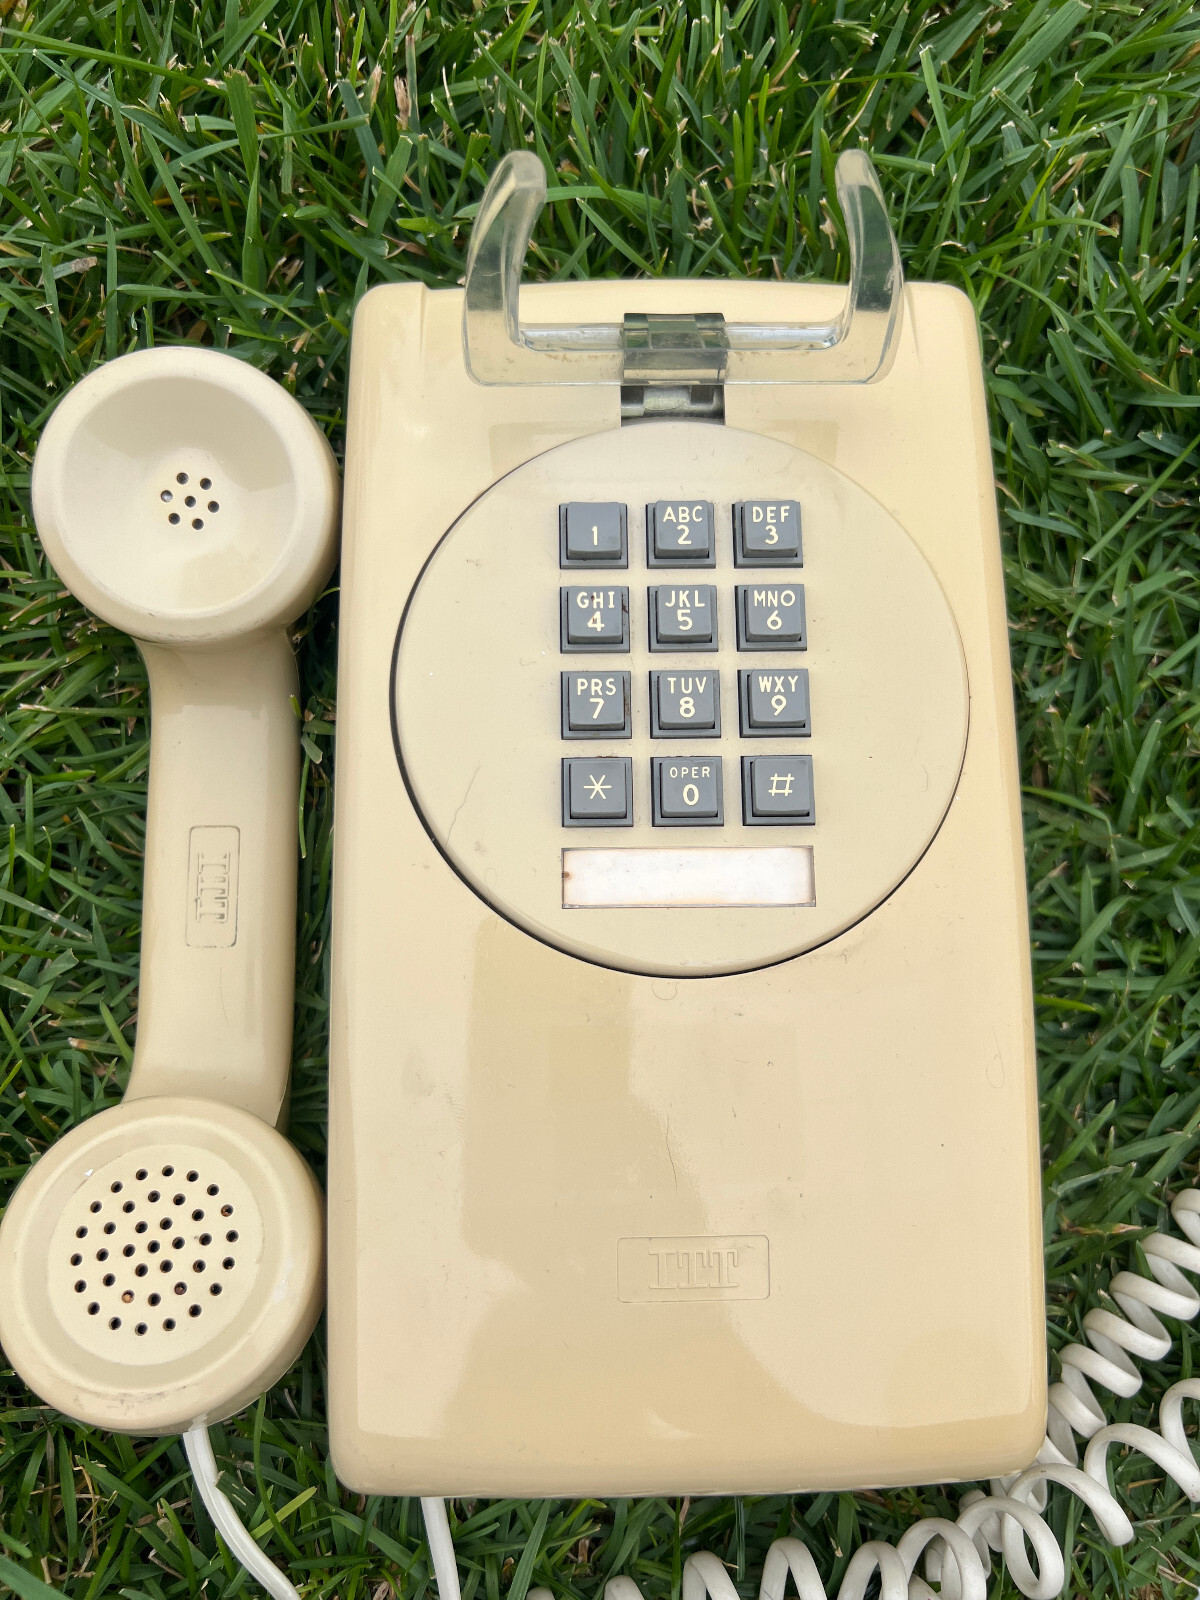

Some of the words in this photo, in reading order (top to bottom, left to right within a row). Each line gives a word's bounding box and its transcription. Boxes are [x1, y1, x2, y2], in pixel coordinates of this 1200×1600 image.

[663, 506, 703, 523] ABC
[753, 506, 789, 522] DEF
[591, 526, 598, 546] 1
[677, 526, 692, 545] 2
[765, 526, 779, 544] 3
[577, 591, 615, 609] GHI
[666, 590, 705, 608] JKL
[754, 590, 796, 606] MNO
[587, 612, 604, 631] 4
[678, 610, 693, 631] 5
[767, 611, 782, 630] 6
[577, 678, 617, 696] PRS
[668, 677, 707, 694] TUV
[758, 676, 798, 692] WXY
[589, 698, 605, 719] 7
[680, 697, 695, 718] 8
[771, 696, 787, 716] 9
[670, 766, 710, 779] OPER
[683, 785, 699, 806] 0
[648, 1247, 740, 1290] ITT
